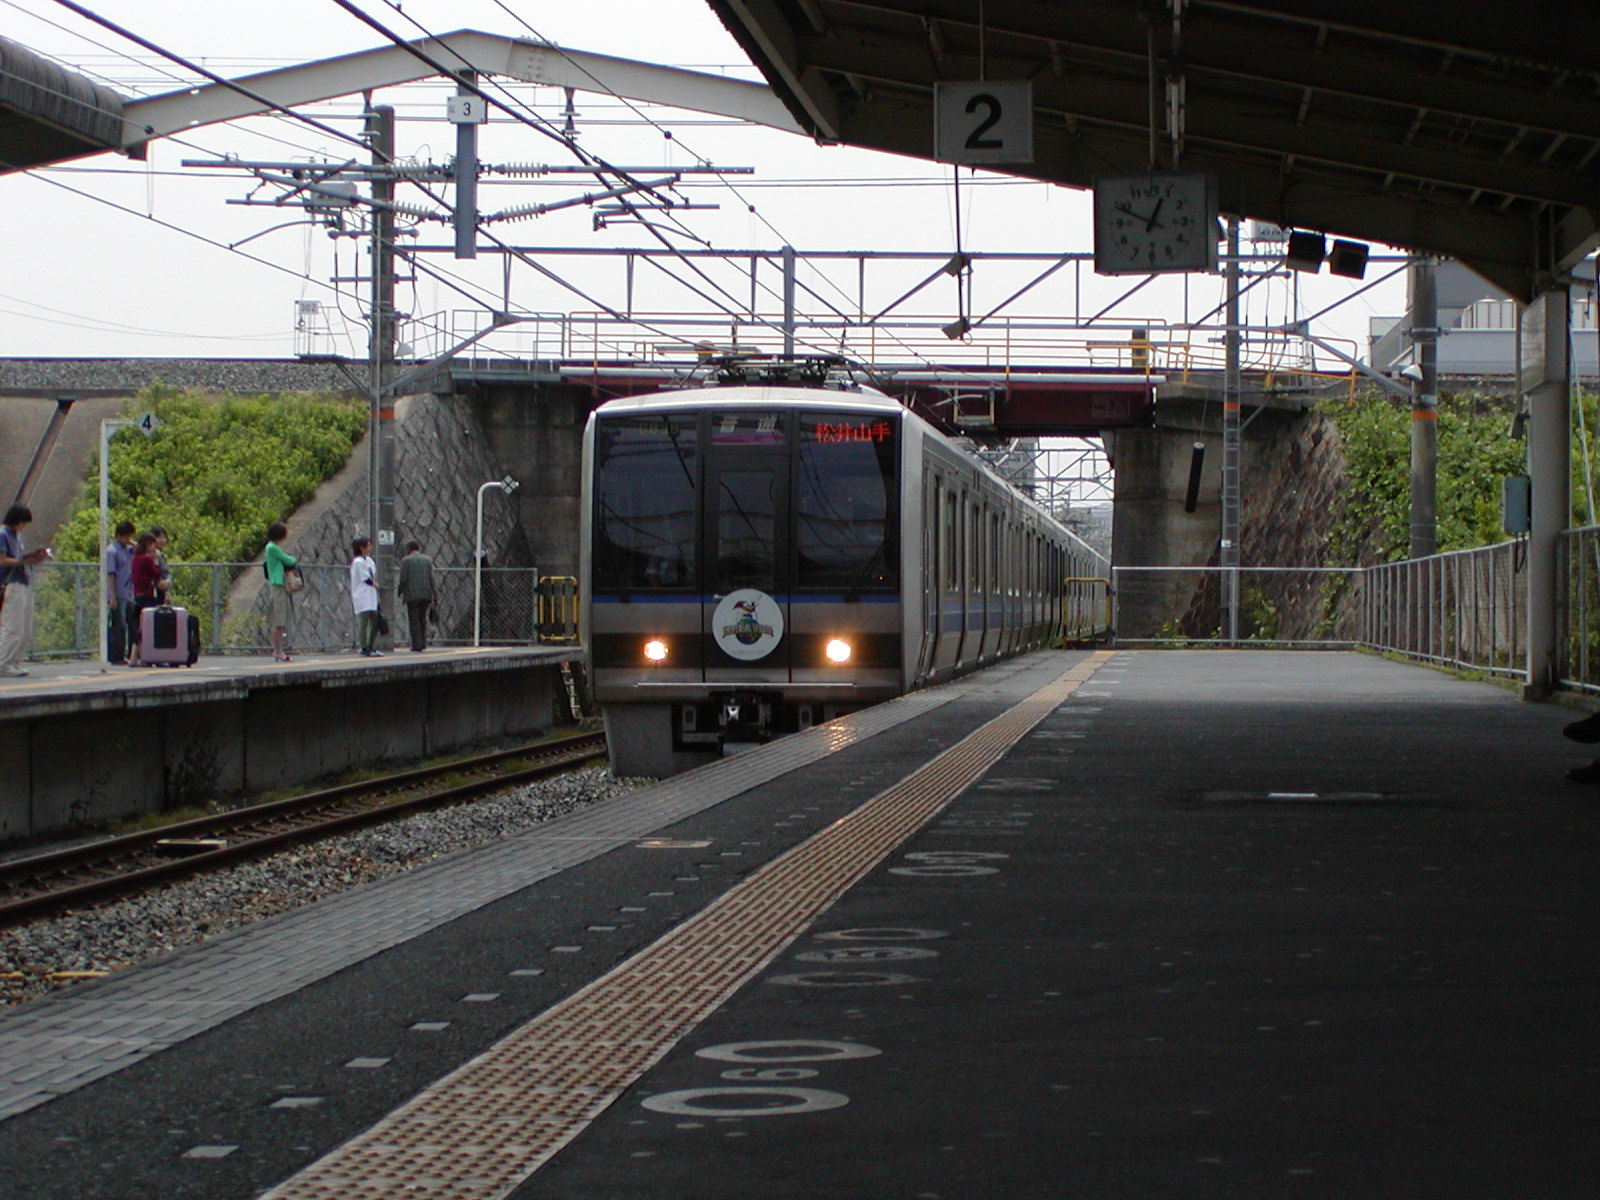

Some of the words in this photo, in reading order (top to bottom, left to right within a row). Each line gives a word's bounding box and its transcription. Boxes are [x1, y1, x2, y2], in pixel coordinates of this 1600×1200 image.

[463, 101, 472, 117] 3
[965, 94, 1003, 149] 2
[142, 414, 152, 430] 4
[814, 421, 892, 443] 松井山手
